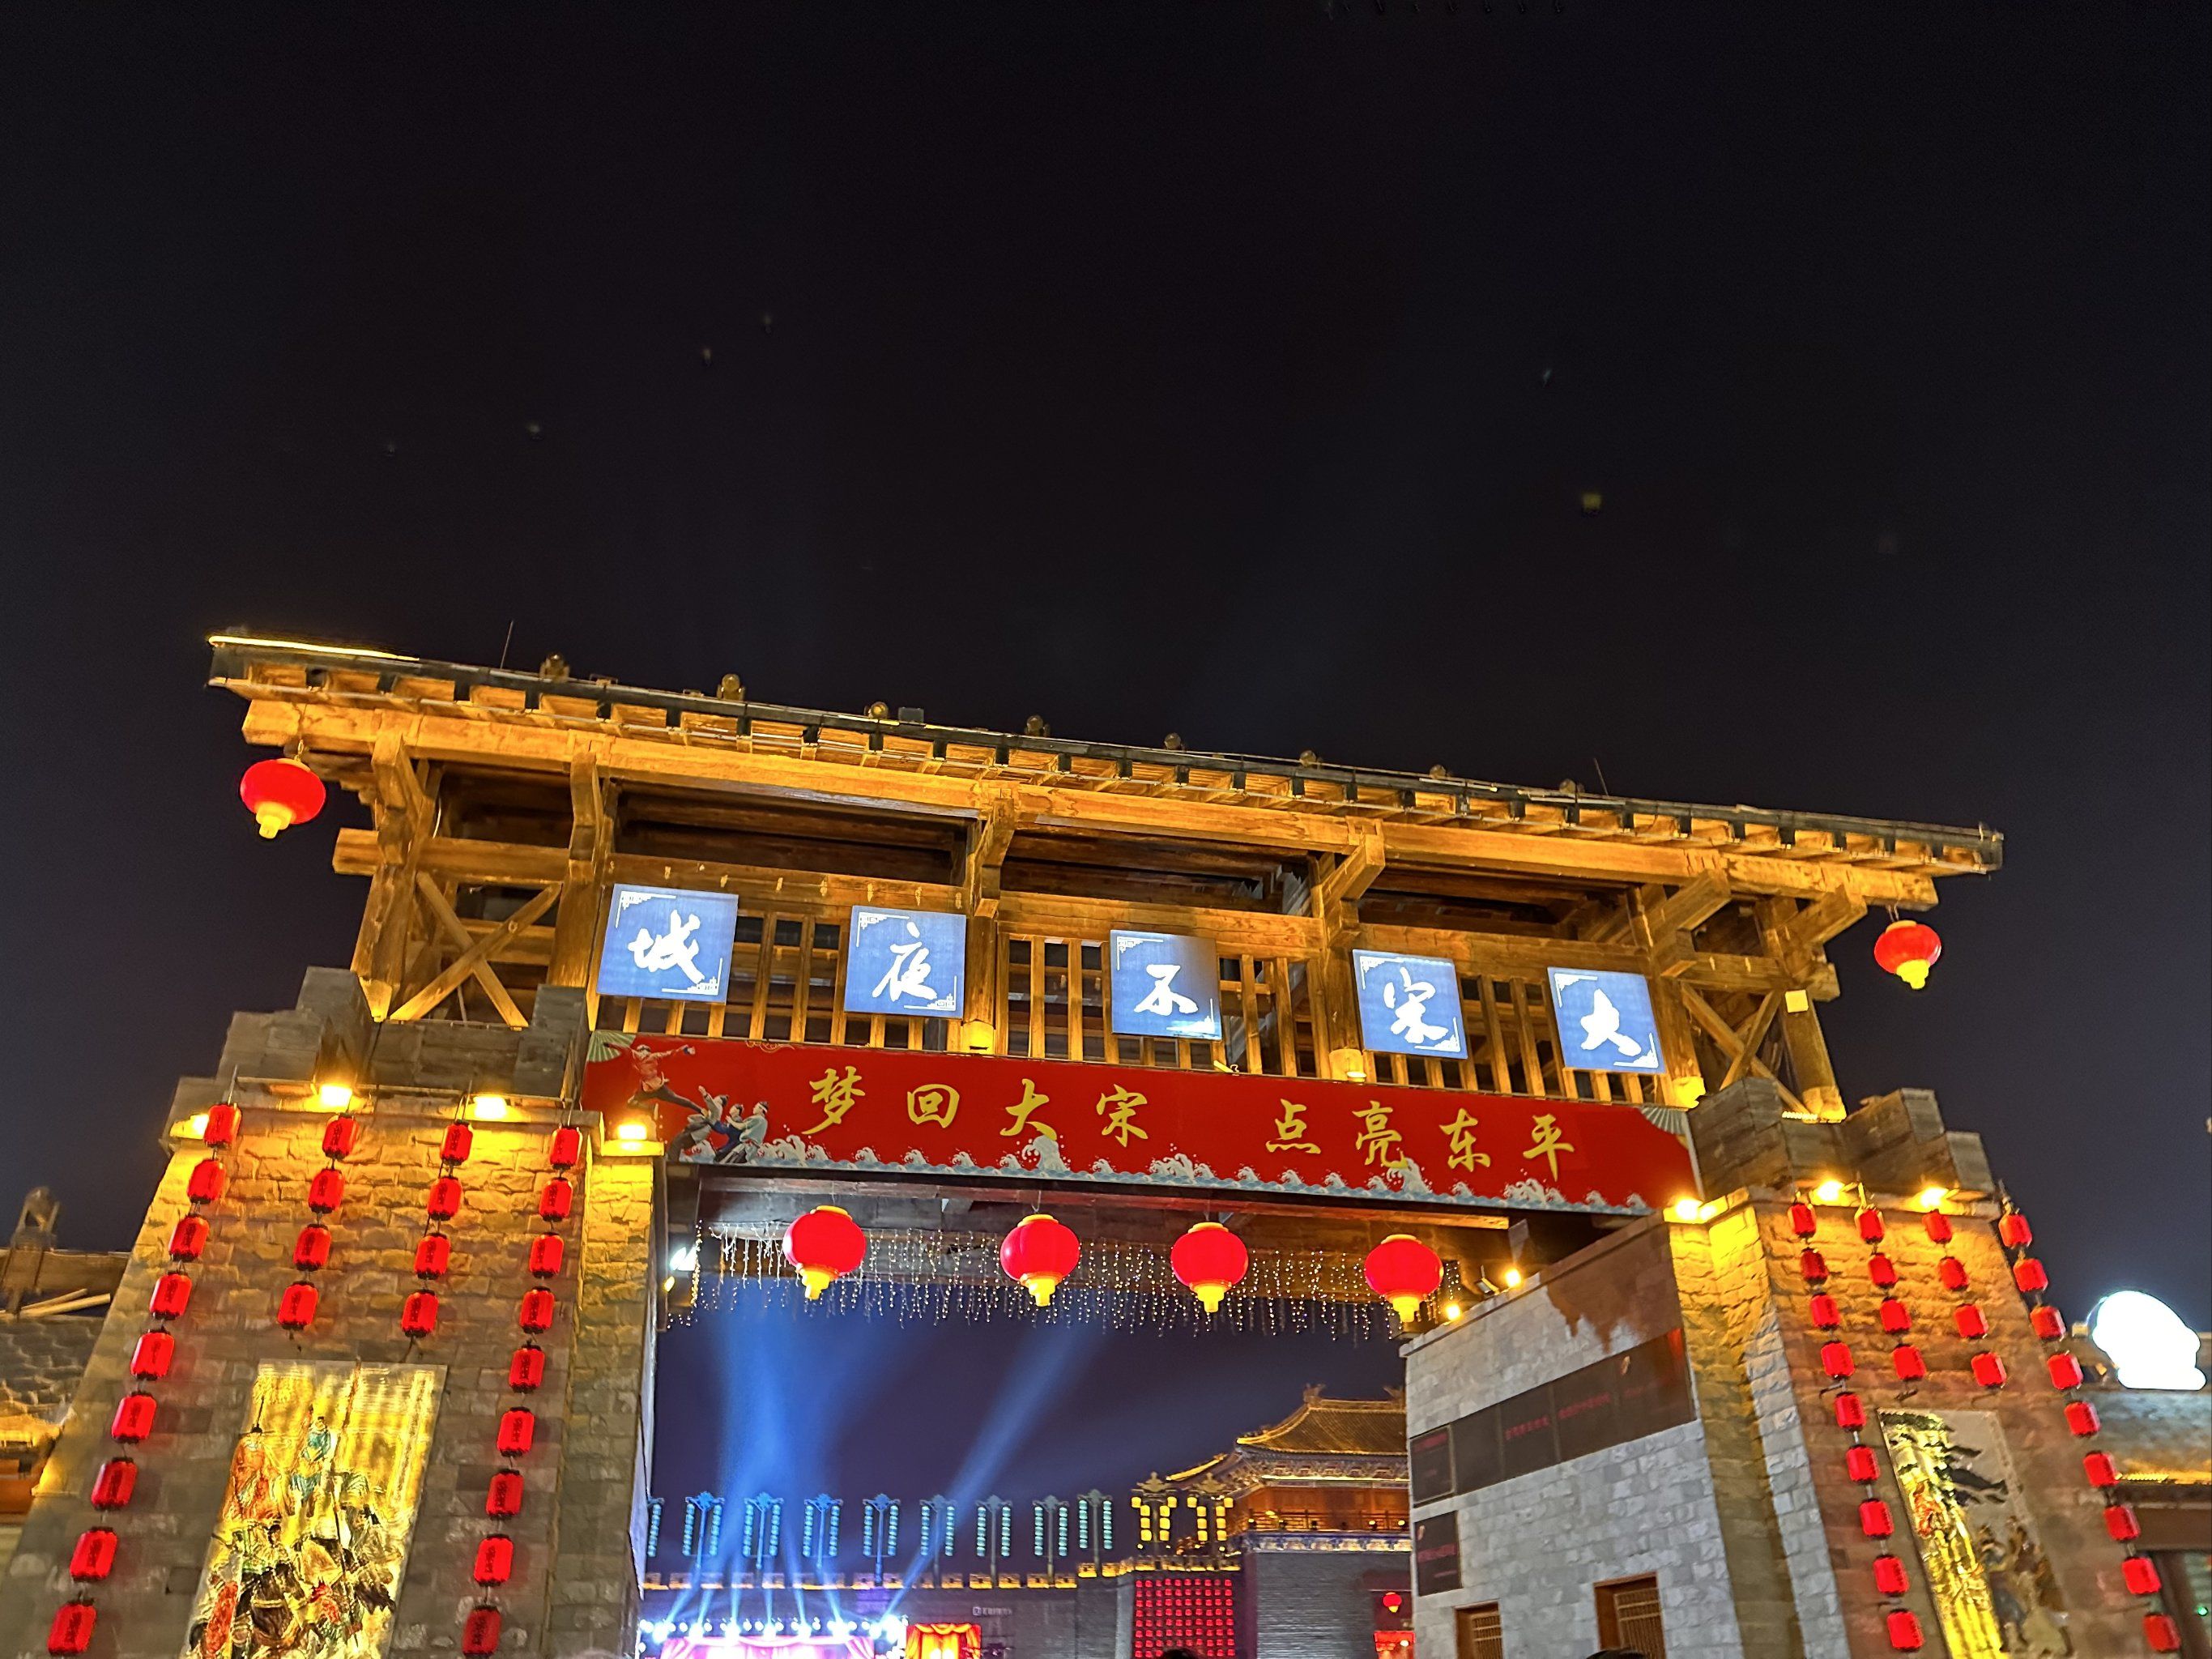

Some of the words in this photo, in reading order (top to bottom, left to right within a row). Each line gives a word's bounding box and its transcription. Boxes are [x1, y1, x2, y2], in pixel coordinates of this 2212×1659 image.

[802, 1066, 1147, 1147] 梦回大宋
[1266, 1098, 1574, 1180] 点亮东平
